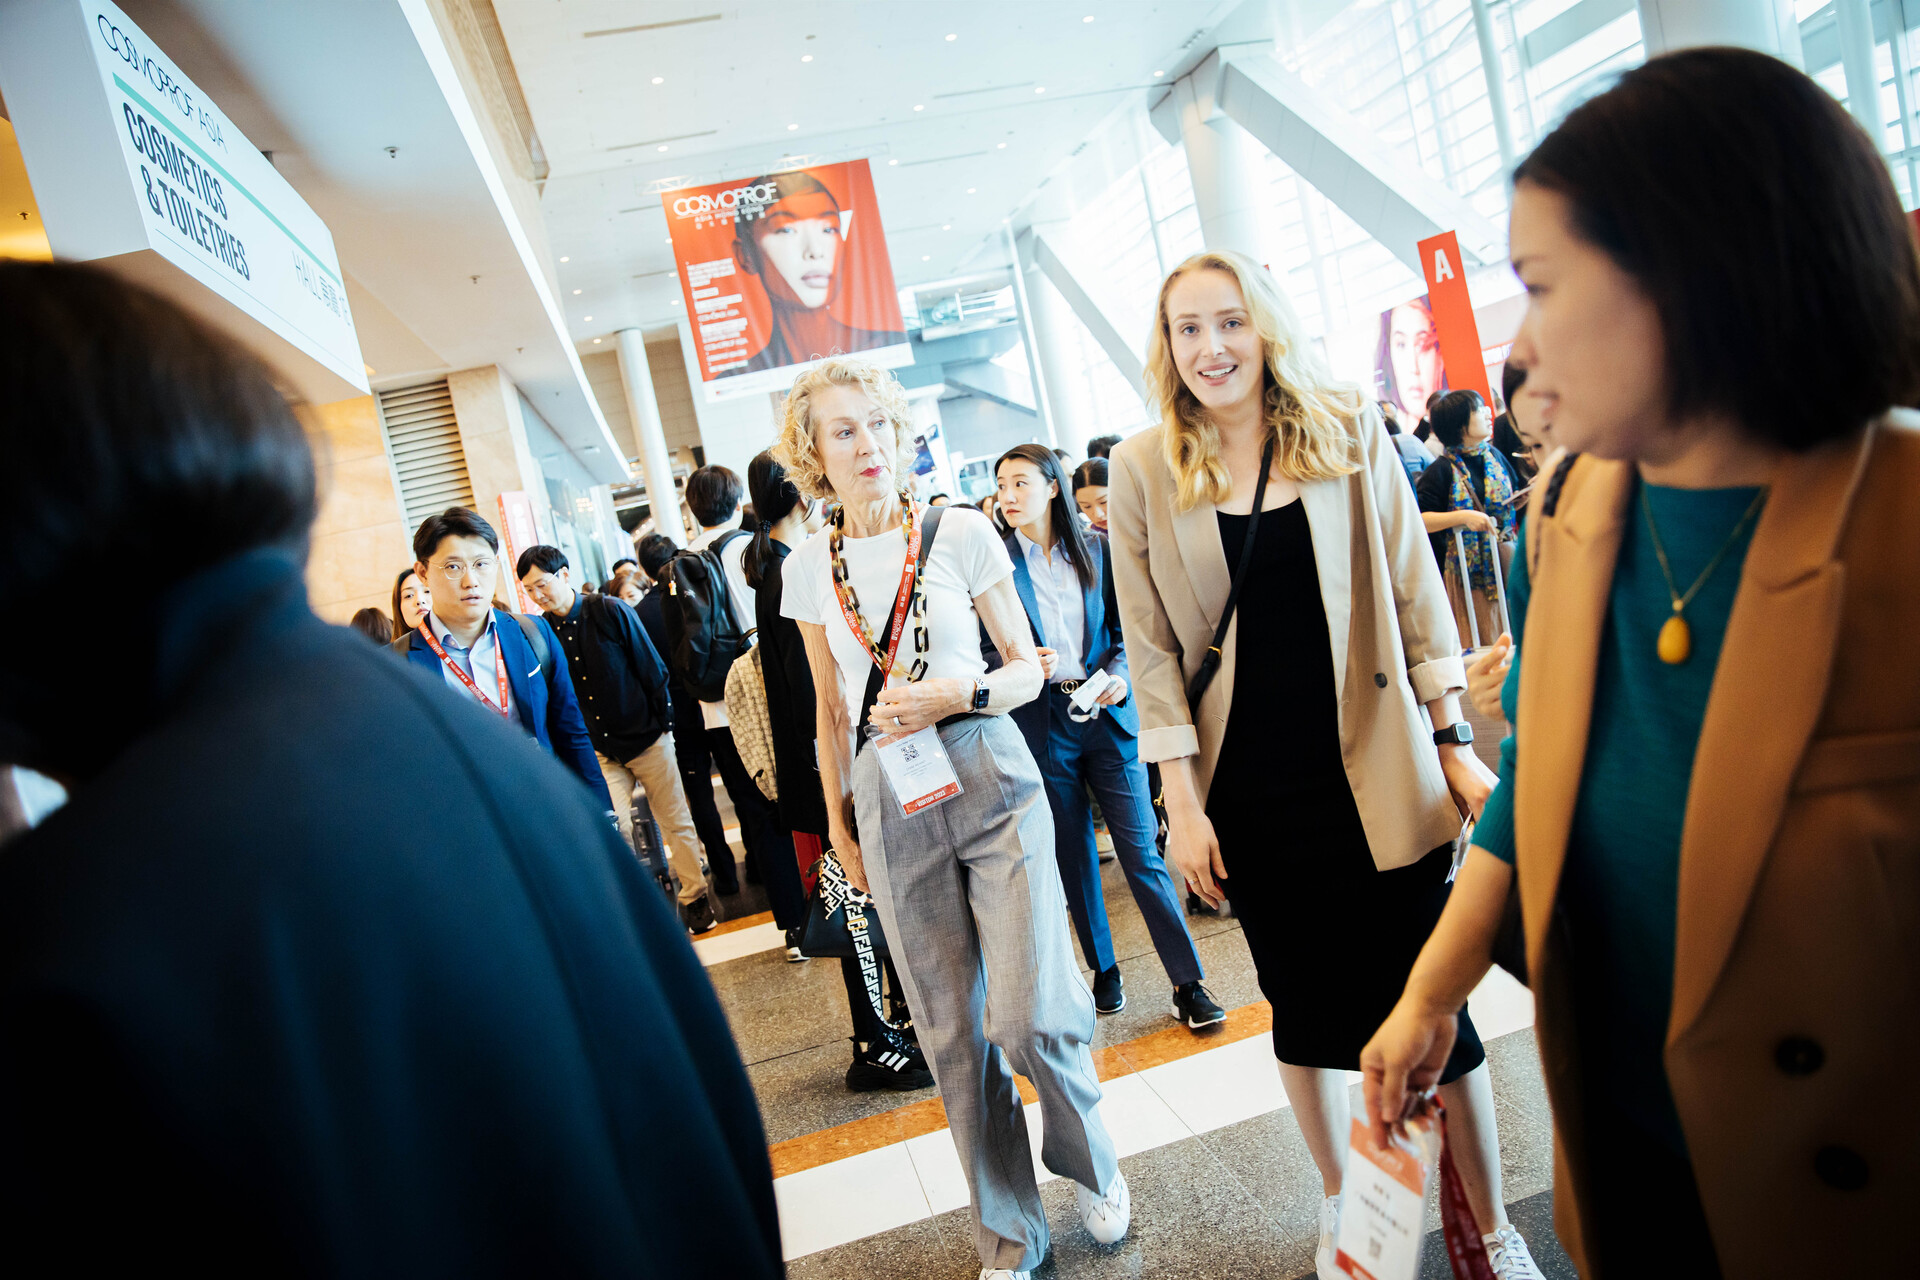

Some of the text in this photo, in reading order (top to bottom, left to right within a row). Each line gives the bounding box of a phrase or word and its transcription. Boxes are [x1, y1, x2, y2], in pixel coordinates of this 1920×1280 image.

[98, 14, 228, 154] COSMOPROF ASIA
[123, 102, 227, 220] COSMETICS
[673, 182, 777, 216] COSMOPROF
[140, 164, 250, 281] & TOILETRIES
[1434, 248, 1455, 284] A
